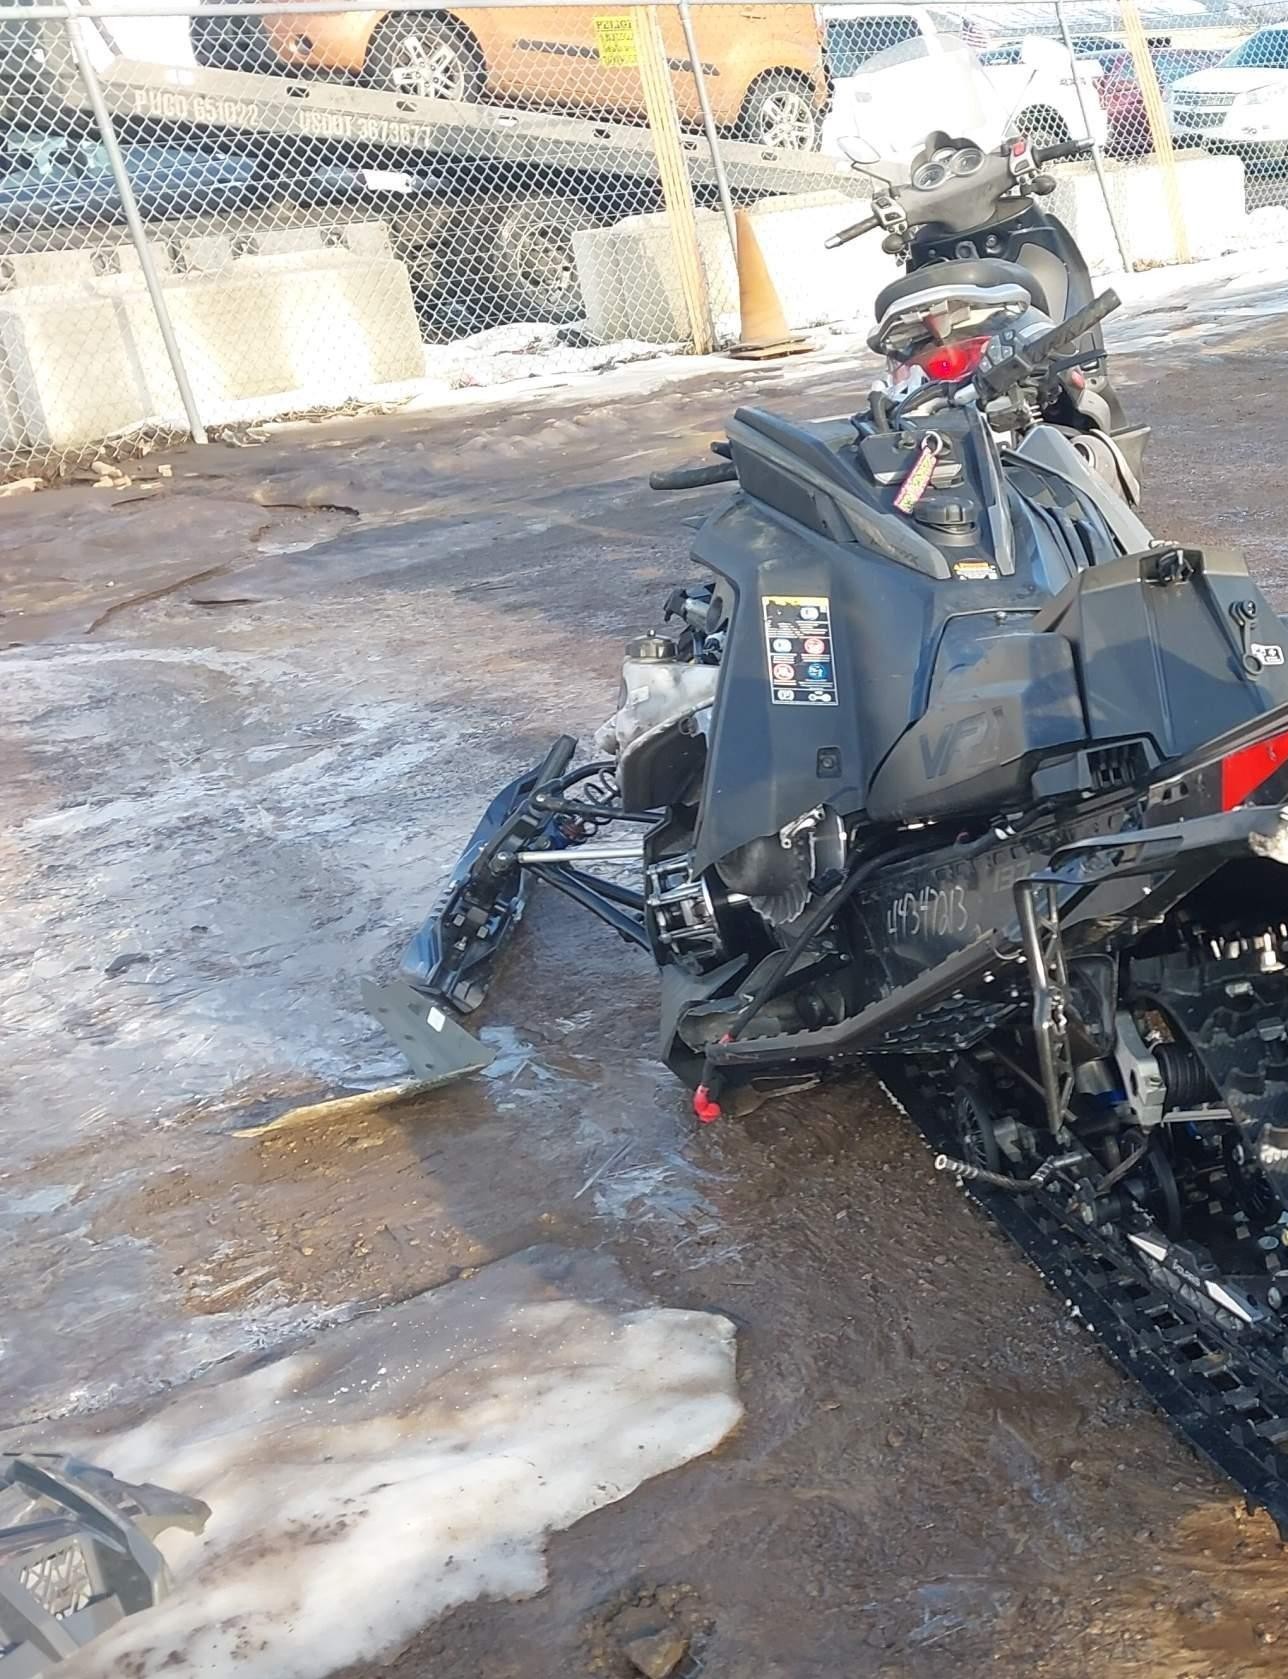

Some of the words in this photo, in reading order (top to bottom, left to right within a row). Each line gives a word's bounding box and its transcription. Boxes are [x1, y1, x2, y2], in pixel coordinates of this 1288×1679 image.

[133, 89, 188, 117] PUCO
[193, 96, 259, 126] 651022
[300, 110, 353, 136] USDOT
[357, 117, 432, 146] 3673677
